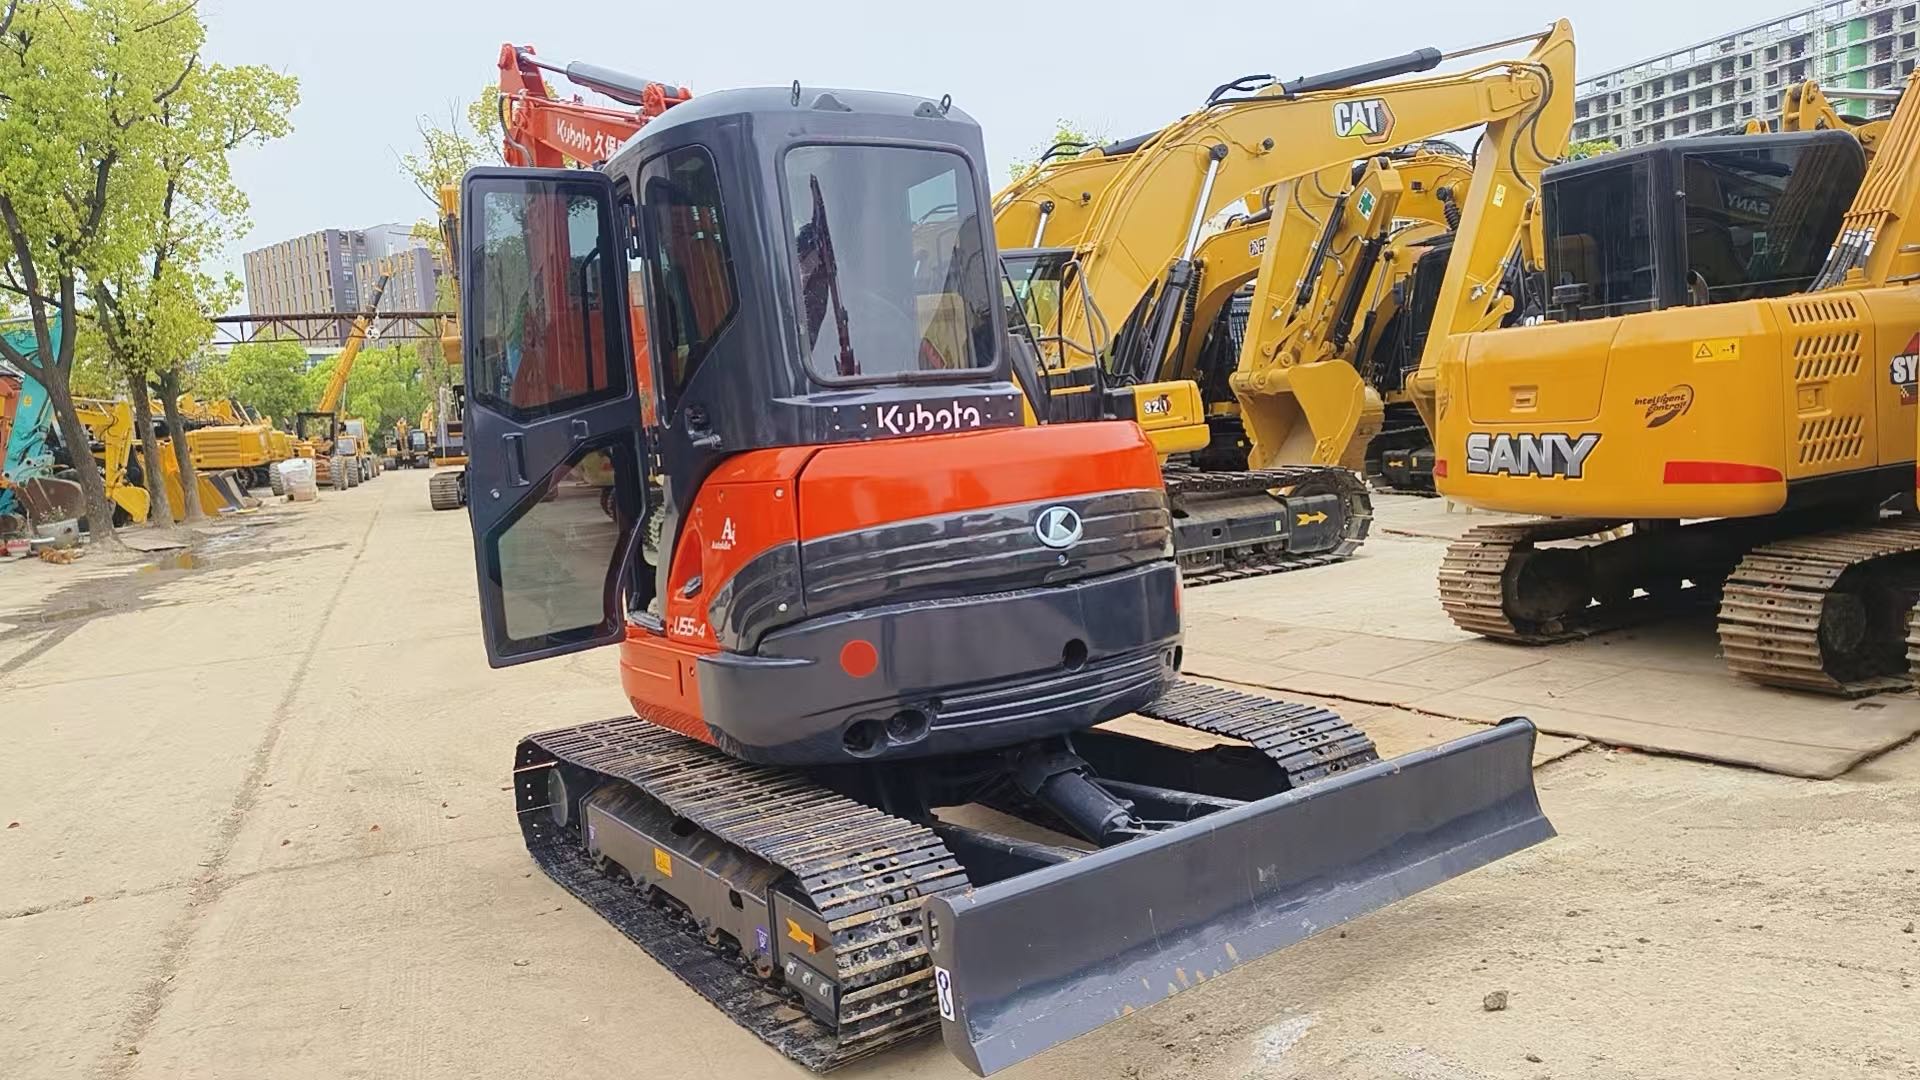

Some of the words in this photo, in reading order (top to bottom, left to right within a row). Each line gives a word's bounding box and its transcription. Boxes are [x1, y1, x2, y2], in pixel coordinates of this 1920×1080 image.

[557, 118, 591, 152] Kubota
[1334, 101, 1379, 136] CAT
[1635, 393, 1686, 405] Intelligent
[877, 400, 980, 434] Kubota
[1466, 433, 1602, 478] SANY
